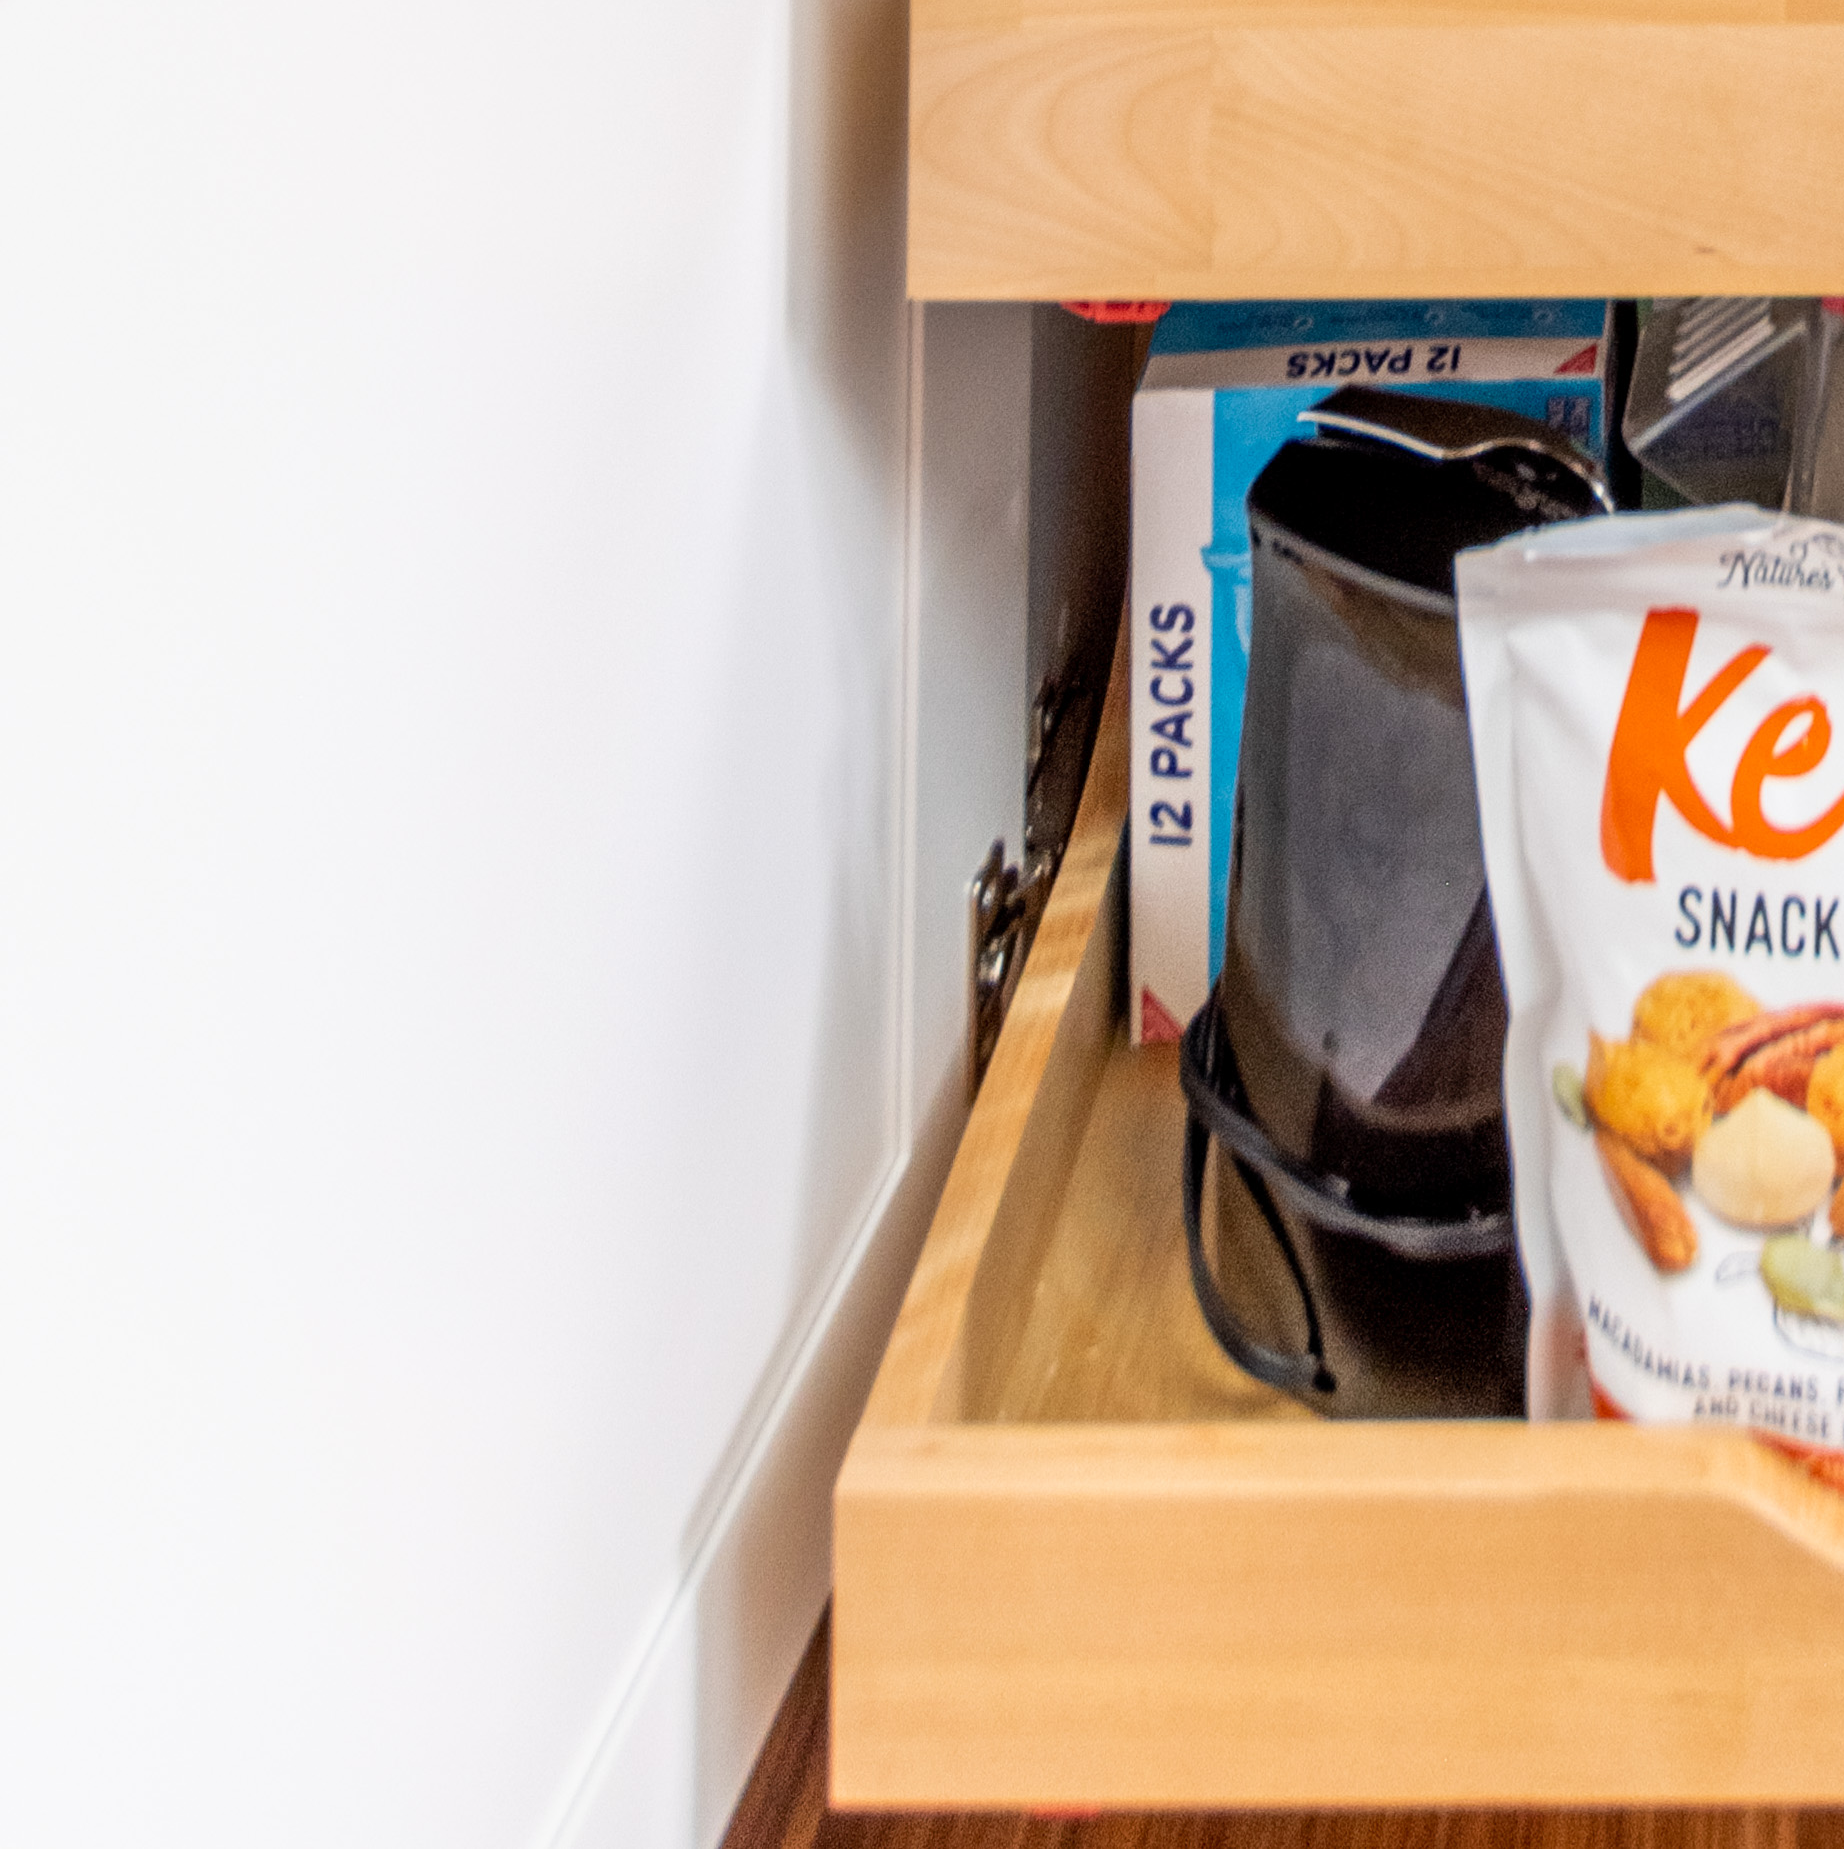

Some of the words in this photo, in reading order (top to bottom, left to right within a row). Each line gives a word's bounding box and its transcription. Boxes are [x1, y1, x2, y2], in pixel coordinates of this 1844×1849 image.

[1286, 345, 1413, 380] PACKS
[1426, 344, 1463, 373] 12
[1149, 602, 1196, 779] PACKS
[1149, 801, 1194, 847] 12
[1675, 886, 1840, 961] SNACK
